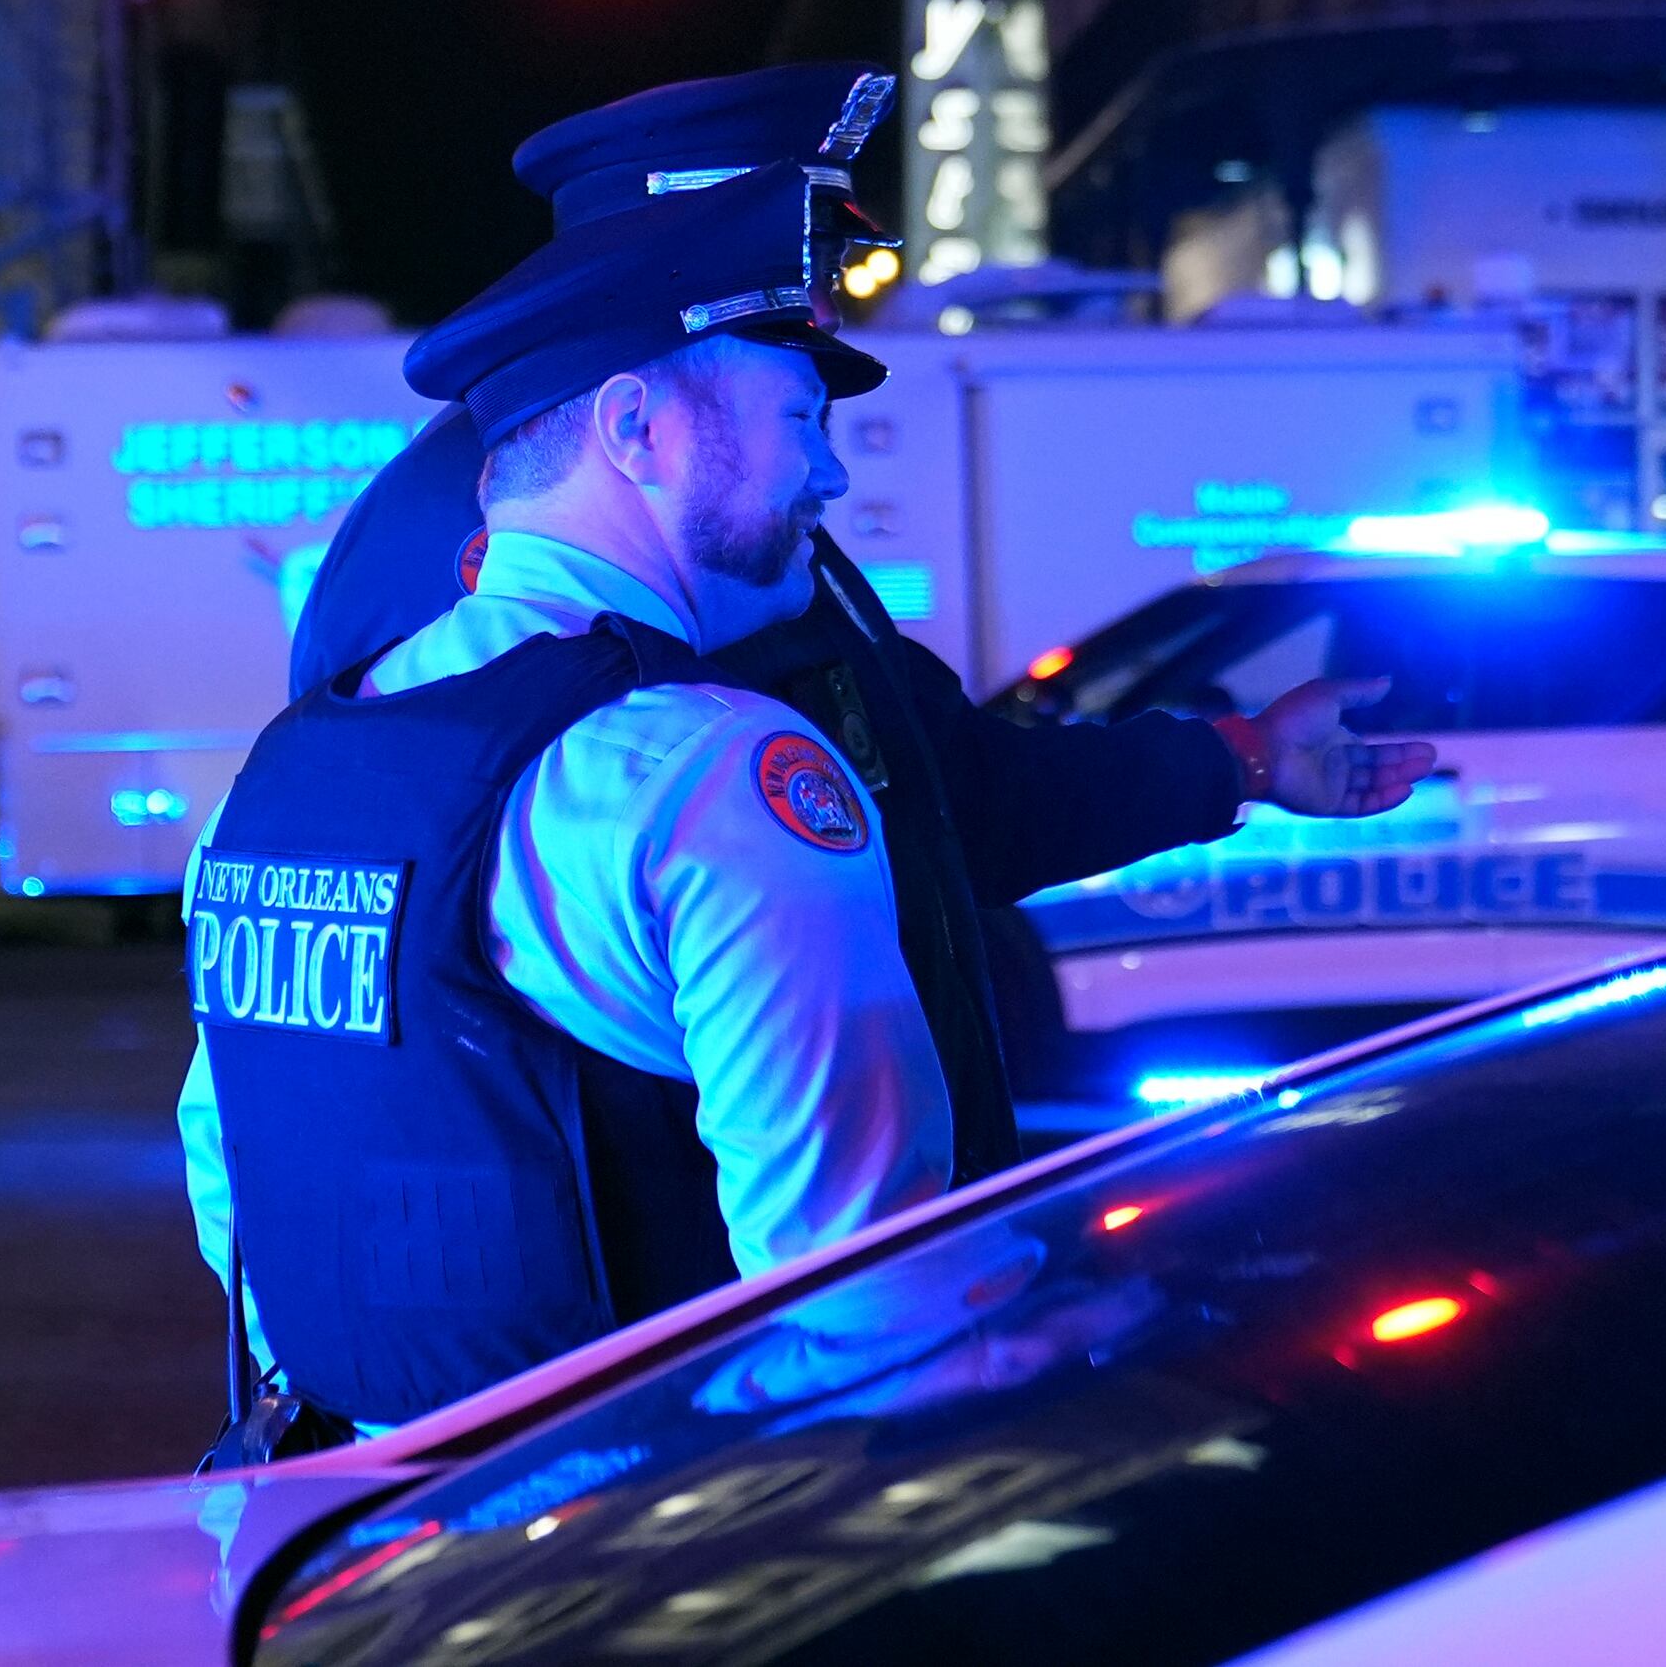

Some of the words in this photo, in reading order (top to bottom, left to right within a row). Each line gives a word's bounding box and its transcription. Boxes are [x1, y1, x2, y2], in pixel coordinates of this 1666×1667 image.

[113, 421, 409, 473] JEFFERSON
[196, 860, 255, 904] NEW
[258, 866, 398, 915] ORLEANS
[1215, 853, 1593, 927] POLICE
[193, 910, 387, 1033] POLICE
